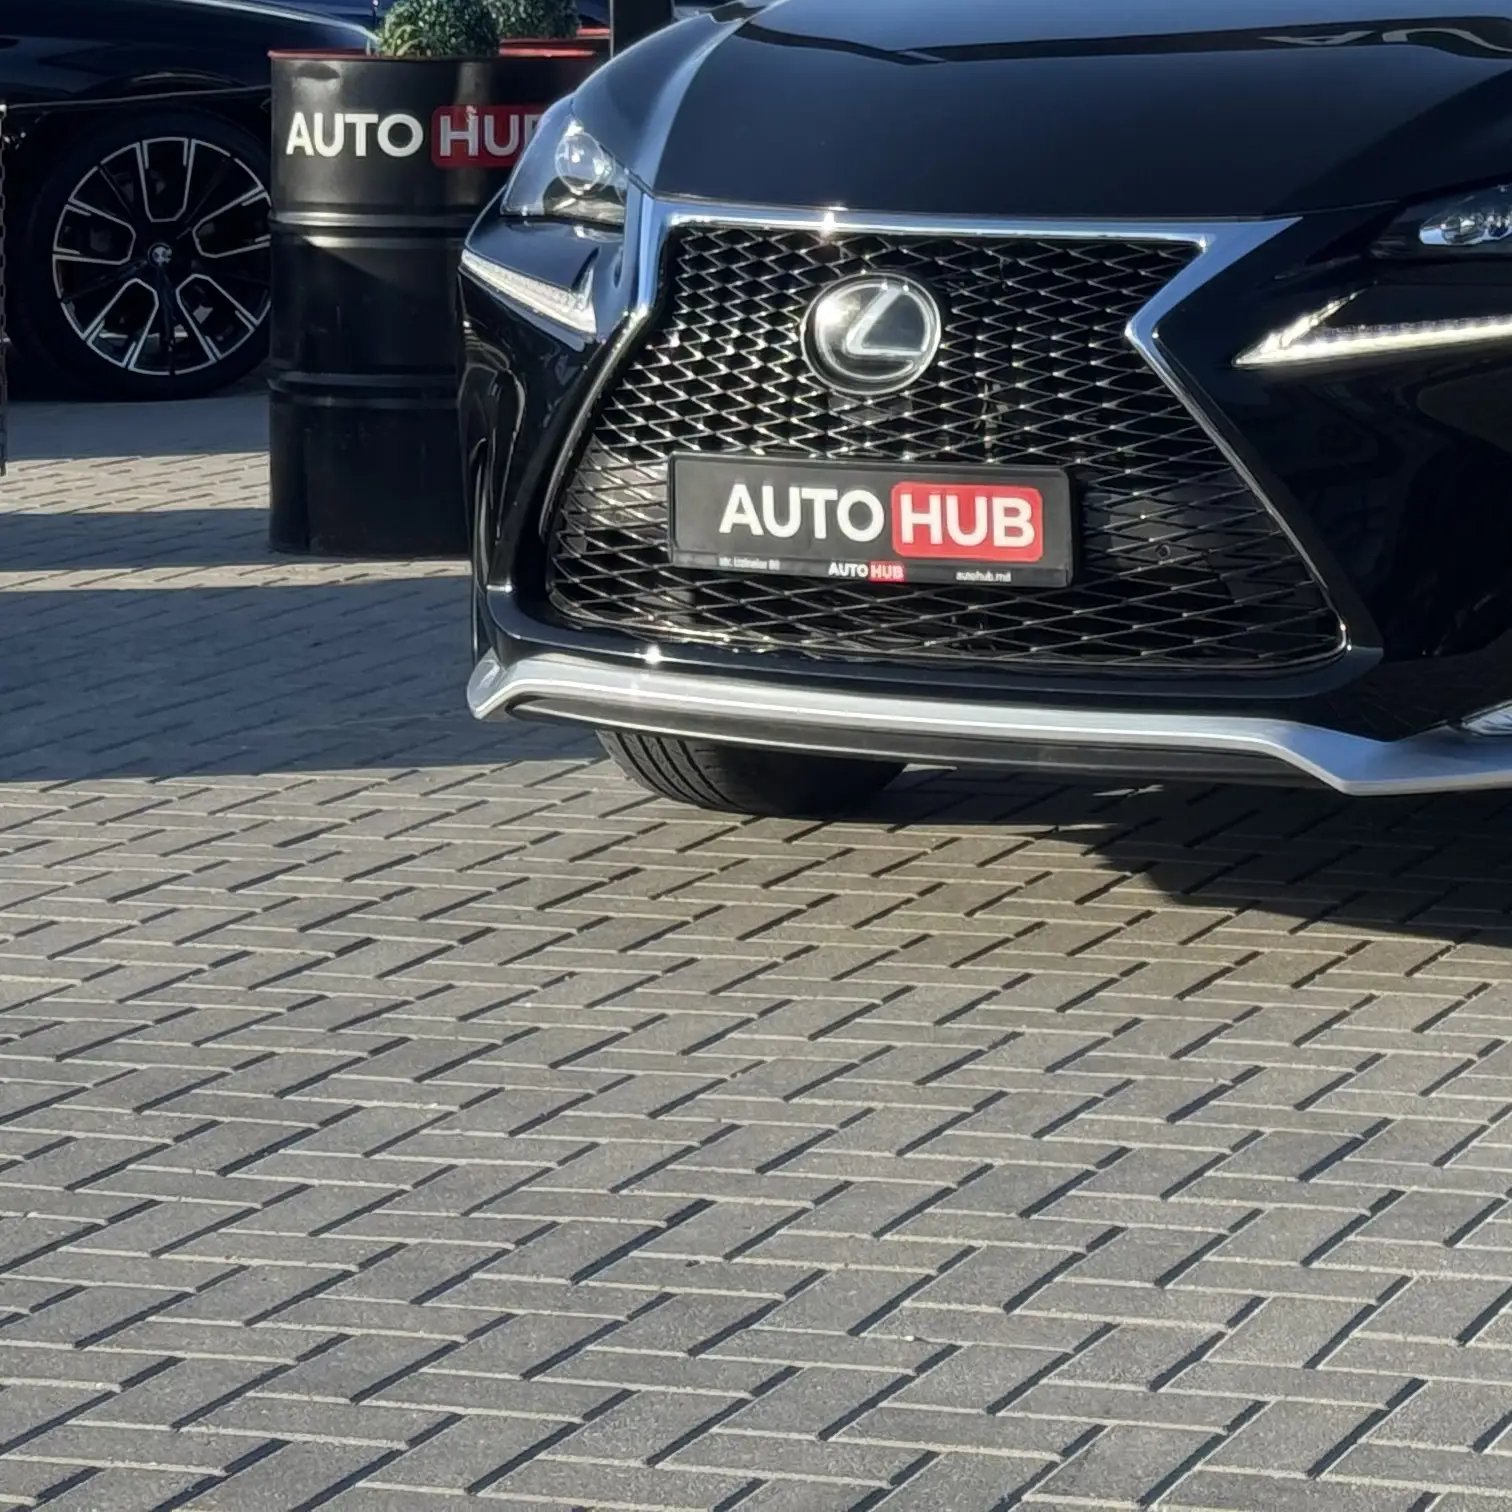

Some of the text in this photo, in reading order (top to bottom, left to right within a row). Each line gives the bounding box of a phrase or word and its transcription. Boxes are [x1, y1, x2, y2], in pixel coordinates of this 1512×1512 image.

[286, 112, 423, 157] AUTO
[719, 482, 1036, 549] AUTO HUB
[828, 561, 905, 580] AUTO HUB
